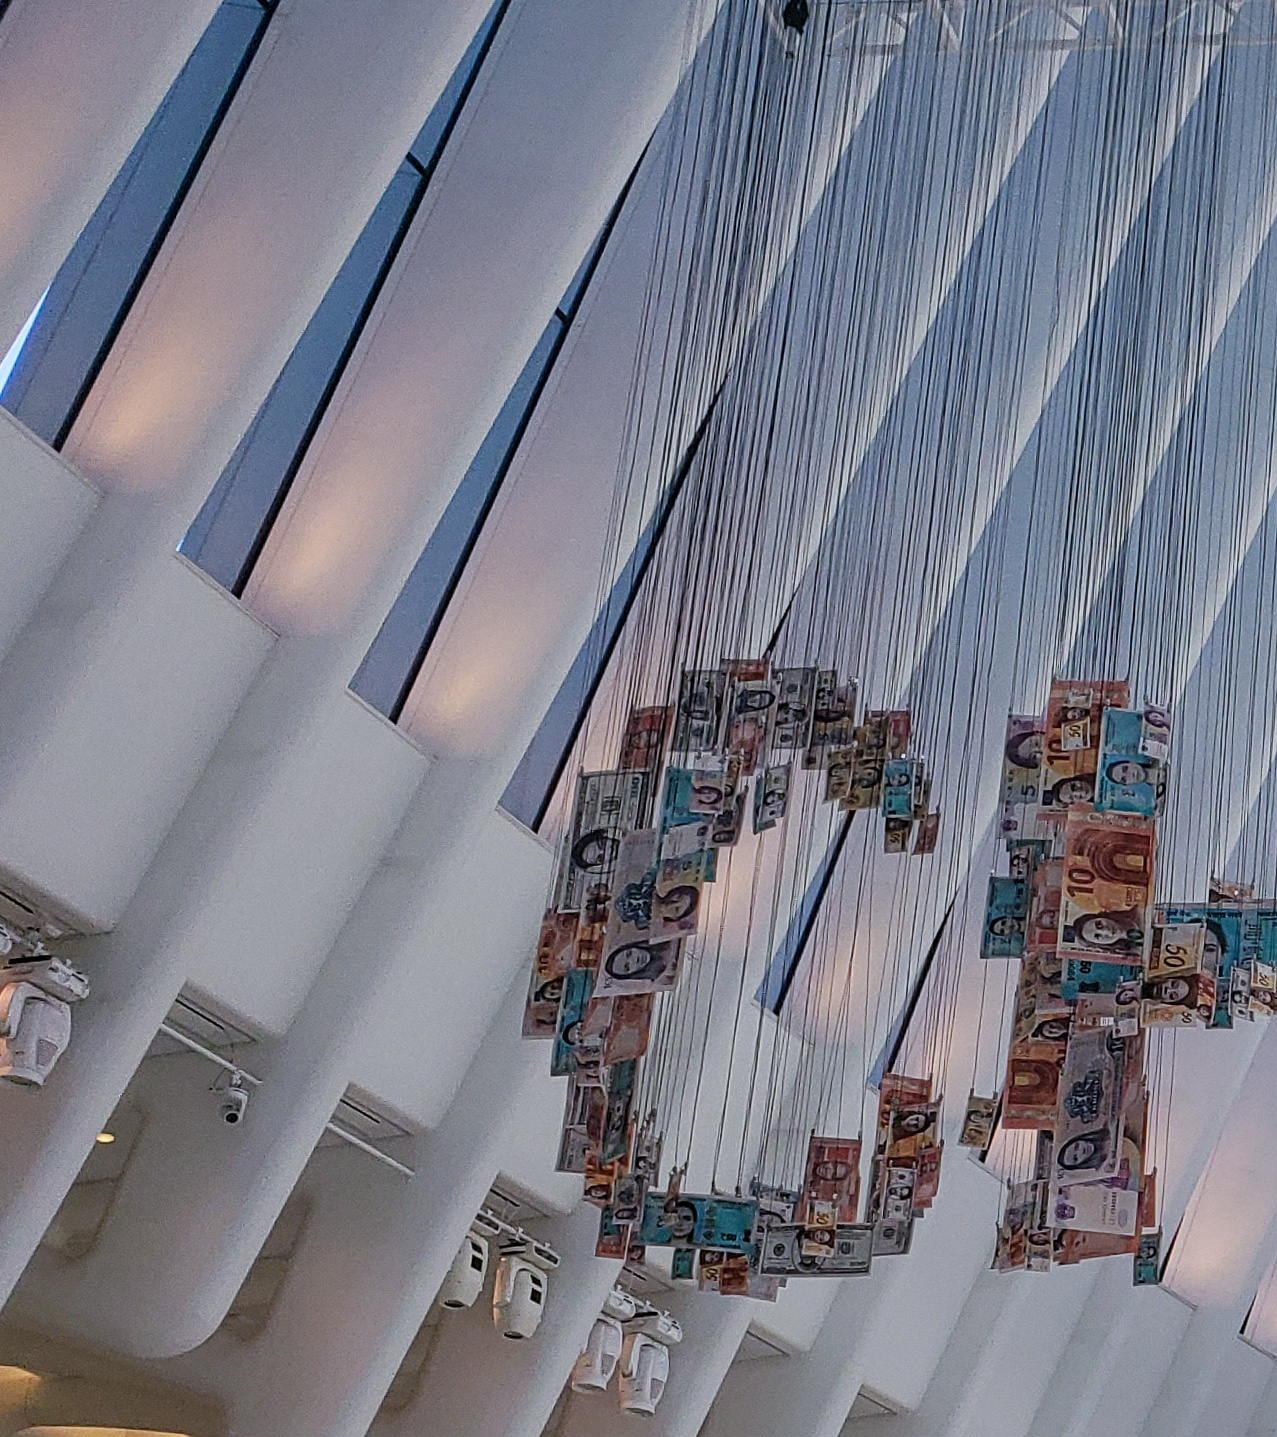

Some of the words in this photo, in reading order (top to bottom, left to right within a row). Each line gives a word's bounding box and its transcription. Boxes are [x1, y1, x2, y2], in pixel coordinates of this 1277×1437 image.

[1067, 867, 1095, 897] 10
[1163, 943, 1188, 967] 50
[1259, 972, 1271, 987] 50
